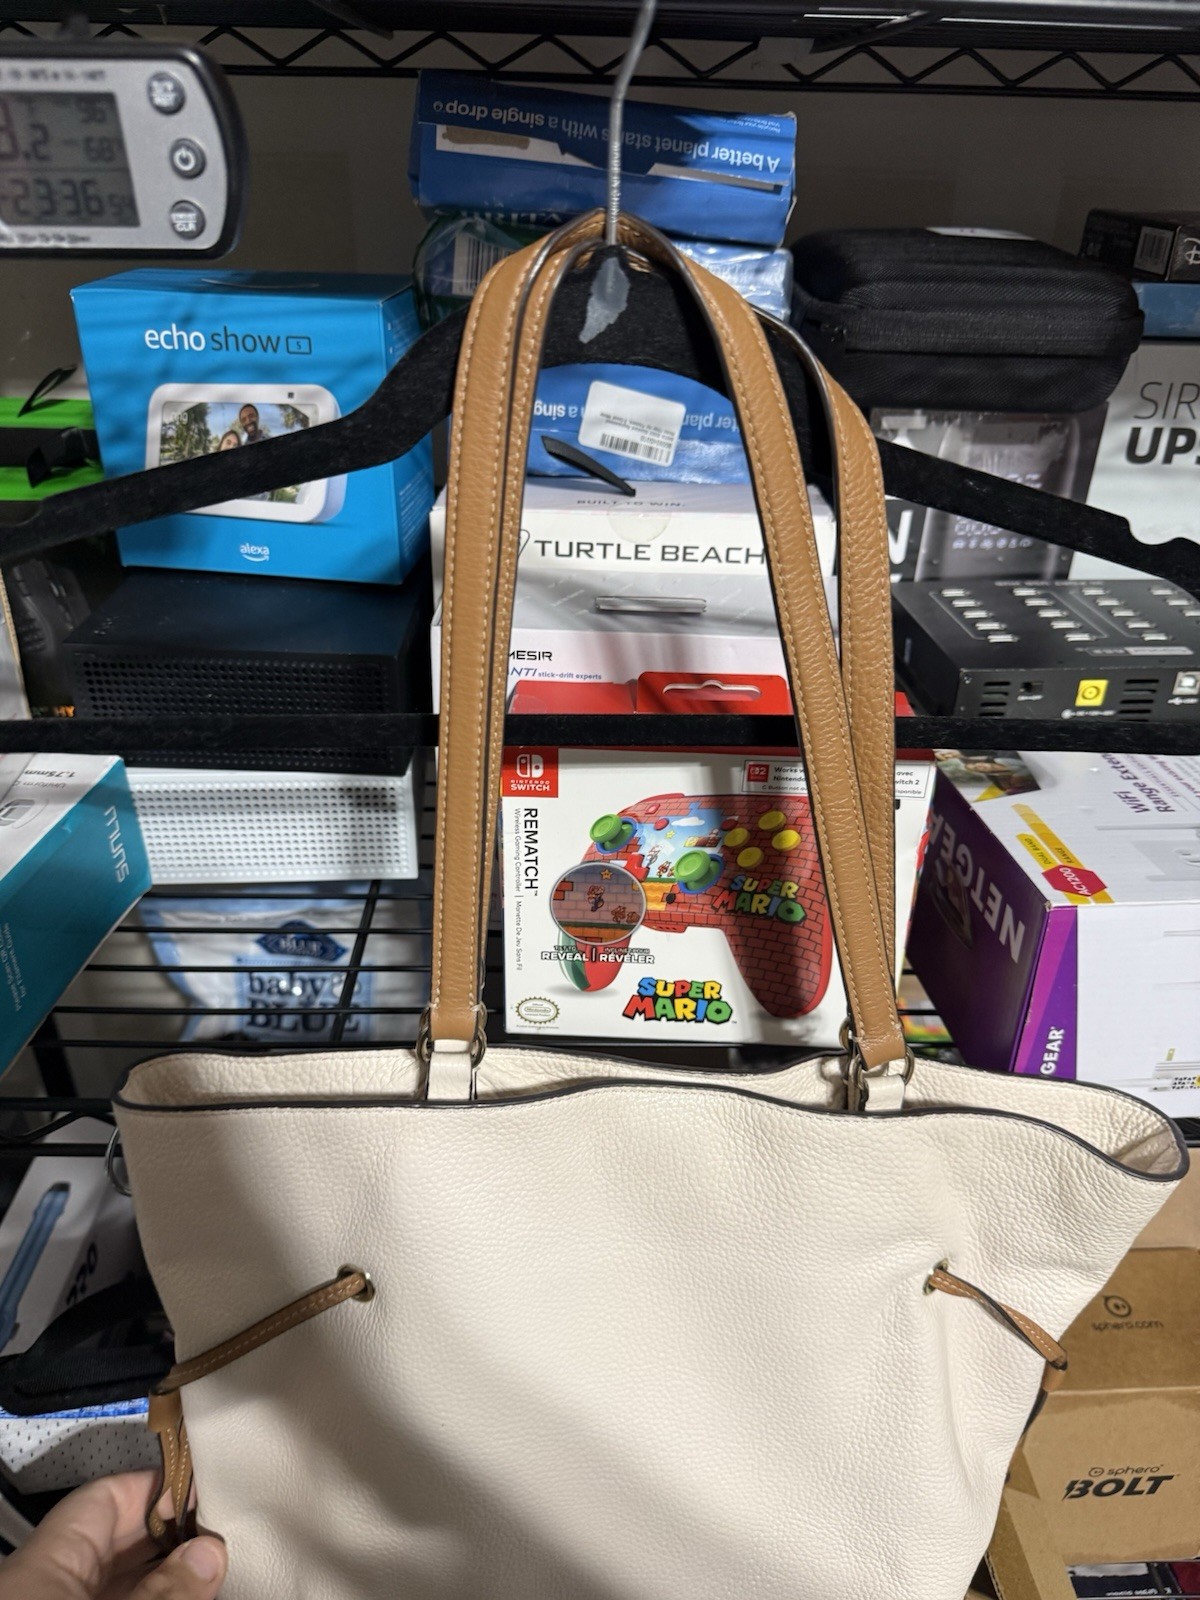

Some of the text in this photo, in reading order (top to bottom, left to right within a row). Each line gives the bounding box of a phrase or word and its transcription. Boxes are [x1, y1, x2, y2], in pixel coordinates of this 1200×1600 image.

[446, 100, 781, 174] A better planet stas with a single drop
[144, 323, 206, 352] echo
[211, 325, 282, 354] show
[568, 406, 578, 419] a
[1125, 426, 1200, 465] UP
[239, 541, 270, 557] alexa
[534, 540, 765, 565] TURTLE BEACH
[507, 667, 602, 681] NTI stick-drift experts
[510, 783, 551, 792] SWITCH
[1132, 781, 1176, 813] Range
[1113, 791, 1151, 813] WiFi
[514, 835, 522, 861] Gaming
[730, 874, 800, 899] SUPER
[1058, 867, 1092, 896] AC1200
[711, 892, 808, 923] MARIO
[541, 952, 590, 962] REVEAL
[637, 976, 722, 999] SUPER
[622, 995, 733, 1024] MARIO
[1091, 1319, 1164, 1332] sphero.com
[1106, 1465, 1160, 1477] sphero
[1062, 1475, 1175, 1500] BOLT
